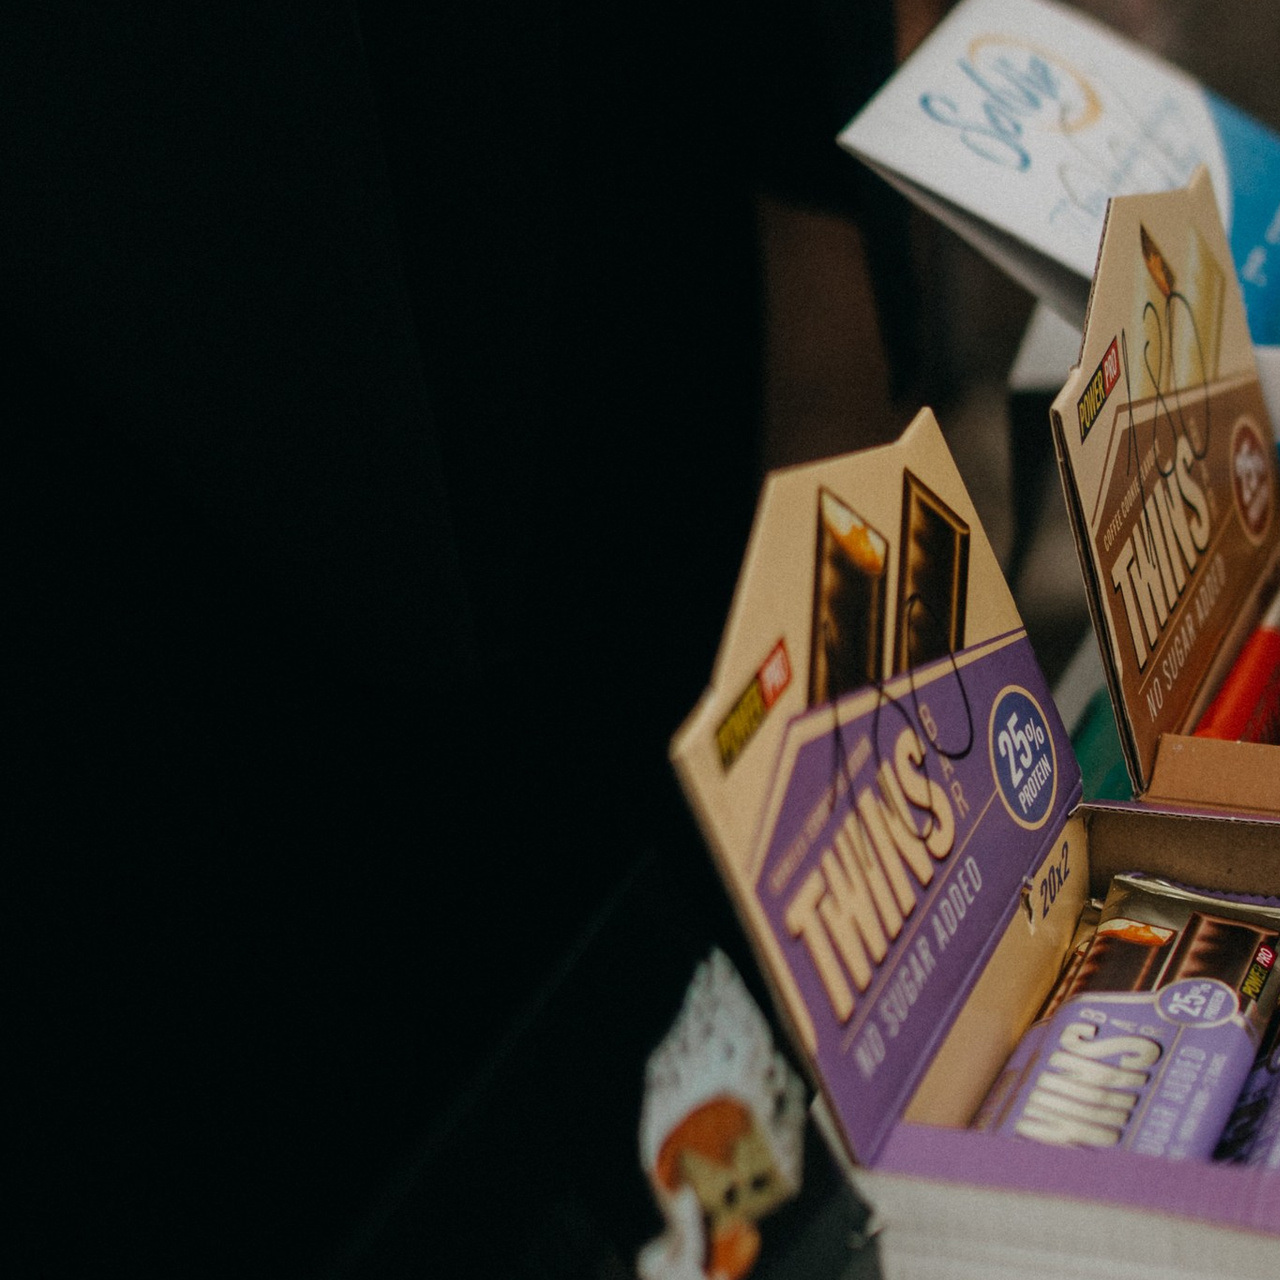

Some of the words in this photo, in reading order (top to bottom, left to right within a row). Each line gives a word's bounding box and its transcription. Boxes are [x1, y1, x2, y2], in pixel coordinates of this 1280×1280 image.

[1079, 368, 1107, 437] POWER
[1103, 348, 1118, 389] PRO
[1110, 434, 1211, 676] TWINS
[1146, 676, 1165, 723] NO
[1161, 613, 1198, 680] SUGAR
[997, 710, 1046, 790] 25%
[1018, 754, 1053, 815] PROTEIN
[784, 725, 958, 1025] TWINS
[1038, 840, 1071, 921] 20x2
[881, 946, 934, 1042] SUGAR
[929, 853, 984, 961] ADDED
[1241, 958, 1272, 1002] POWER
[1255, 944, 1277, 969] PRO
[1167, 979, 1213, 1021] 25%
